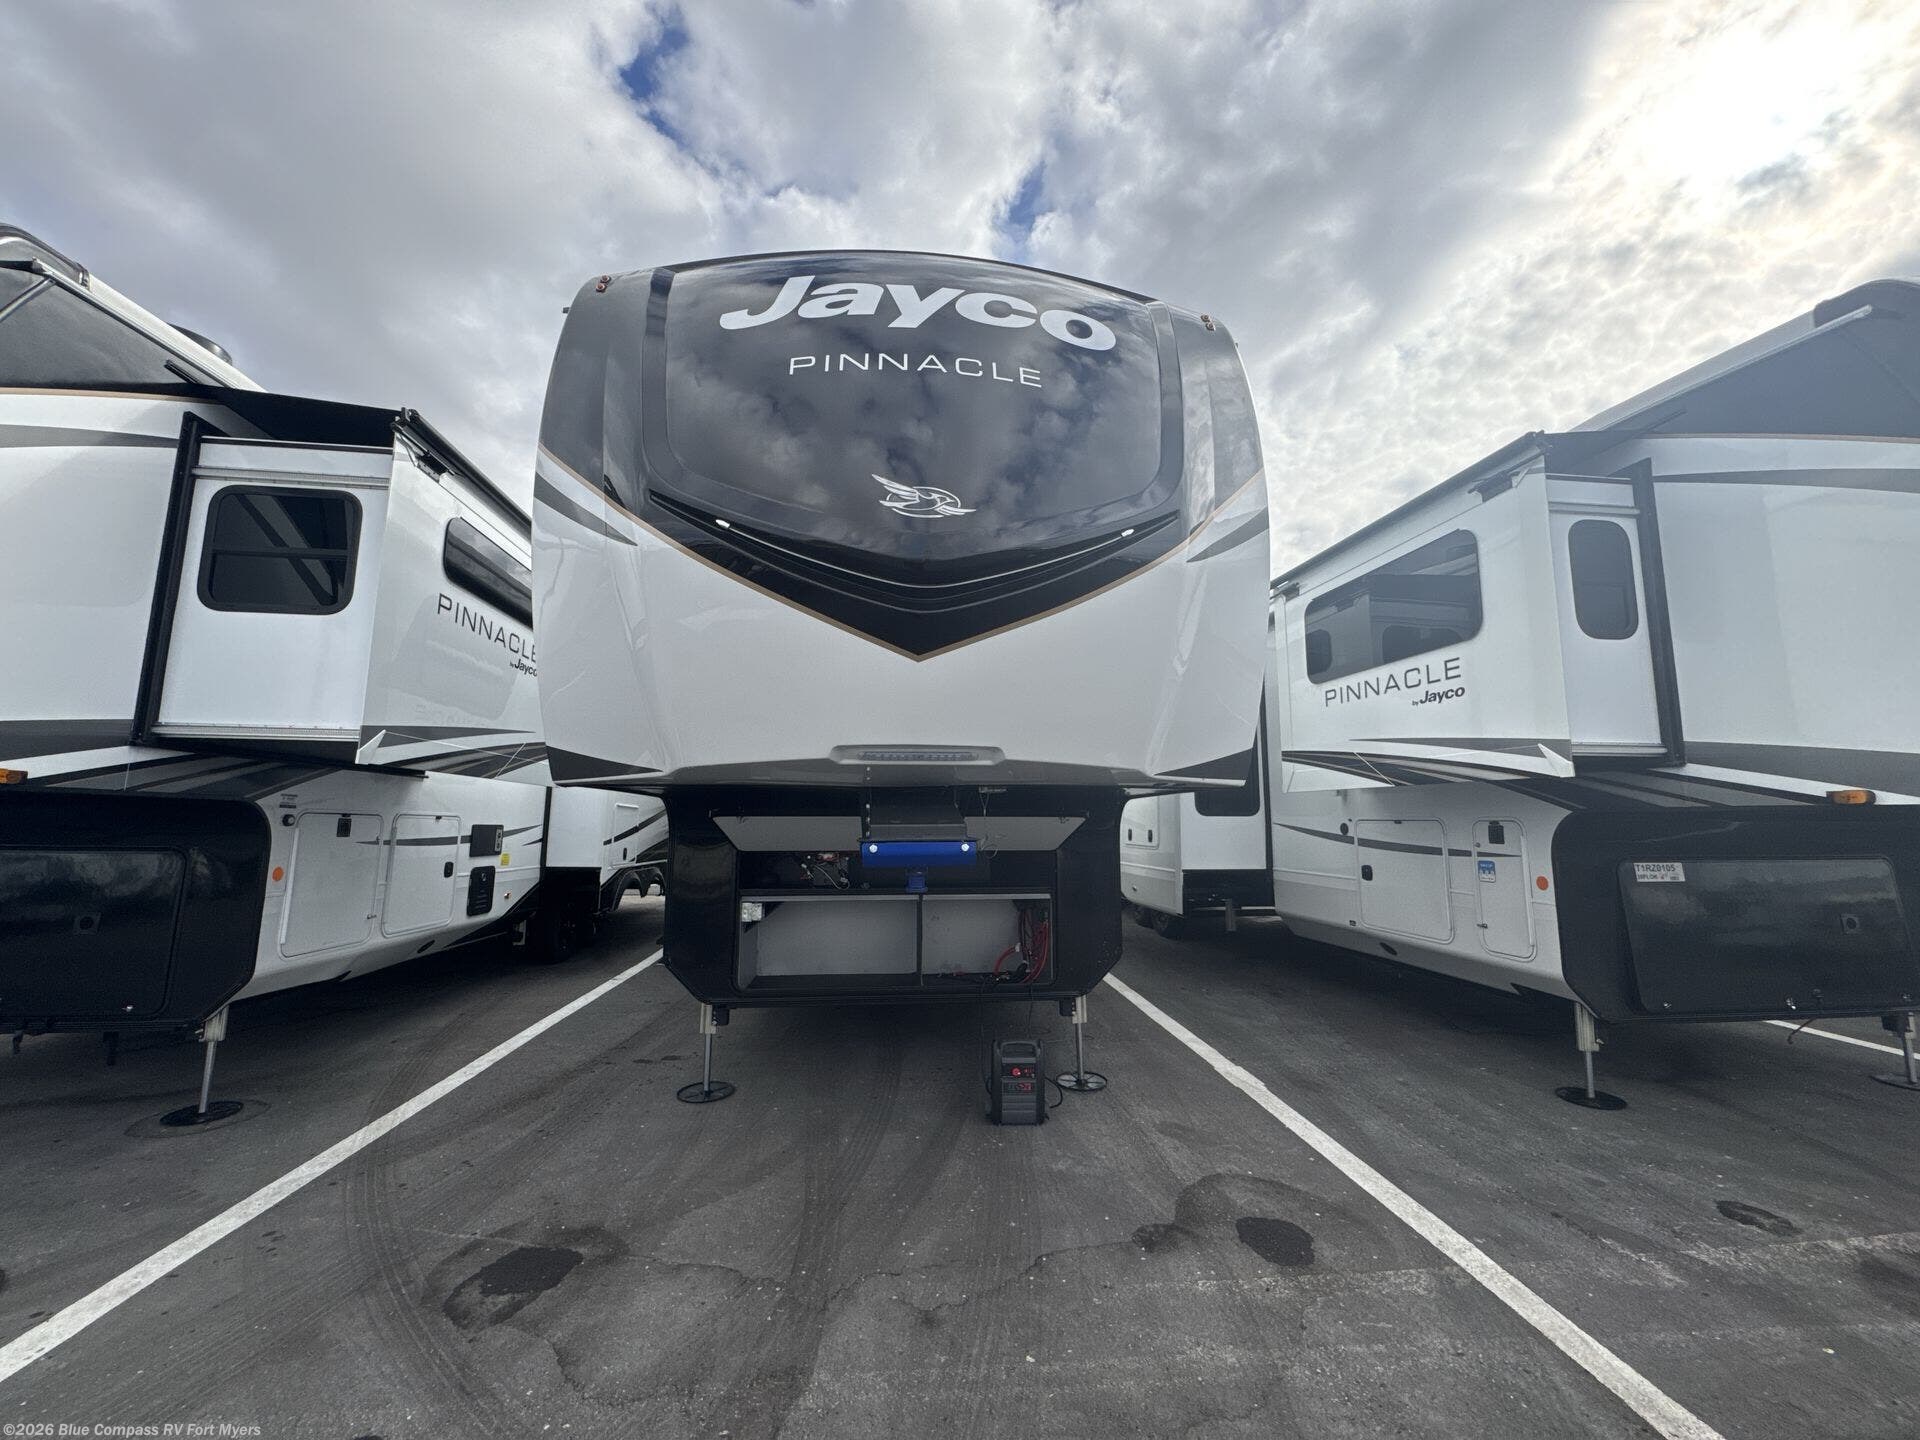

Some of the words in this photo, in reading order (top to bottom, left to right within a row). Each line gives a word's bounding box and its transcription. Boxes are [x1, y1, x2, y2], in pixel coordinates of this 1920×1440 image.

[720, 275, 1117, 350] Jayco
[788, 352, 1043, 388] PINNACLE
[1324, 657, 1462, 707] PINNACLE
[1419, 687, 1466, 704] Jayco
